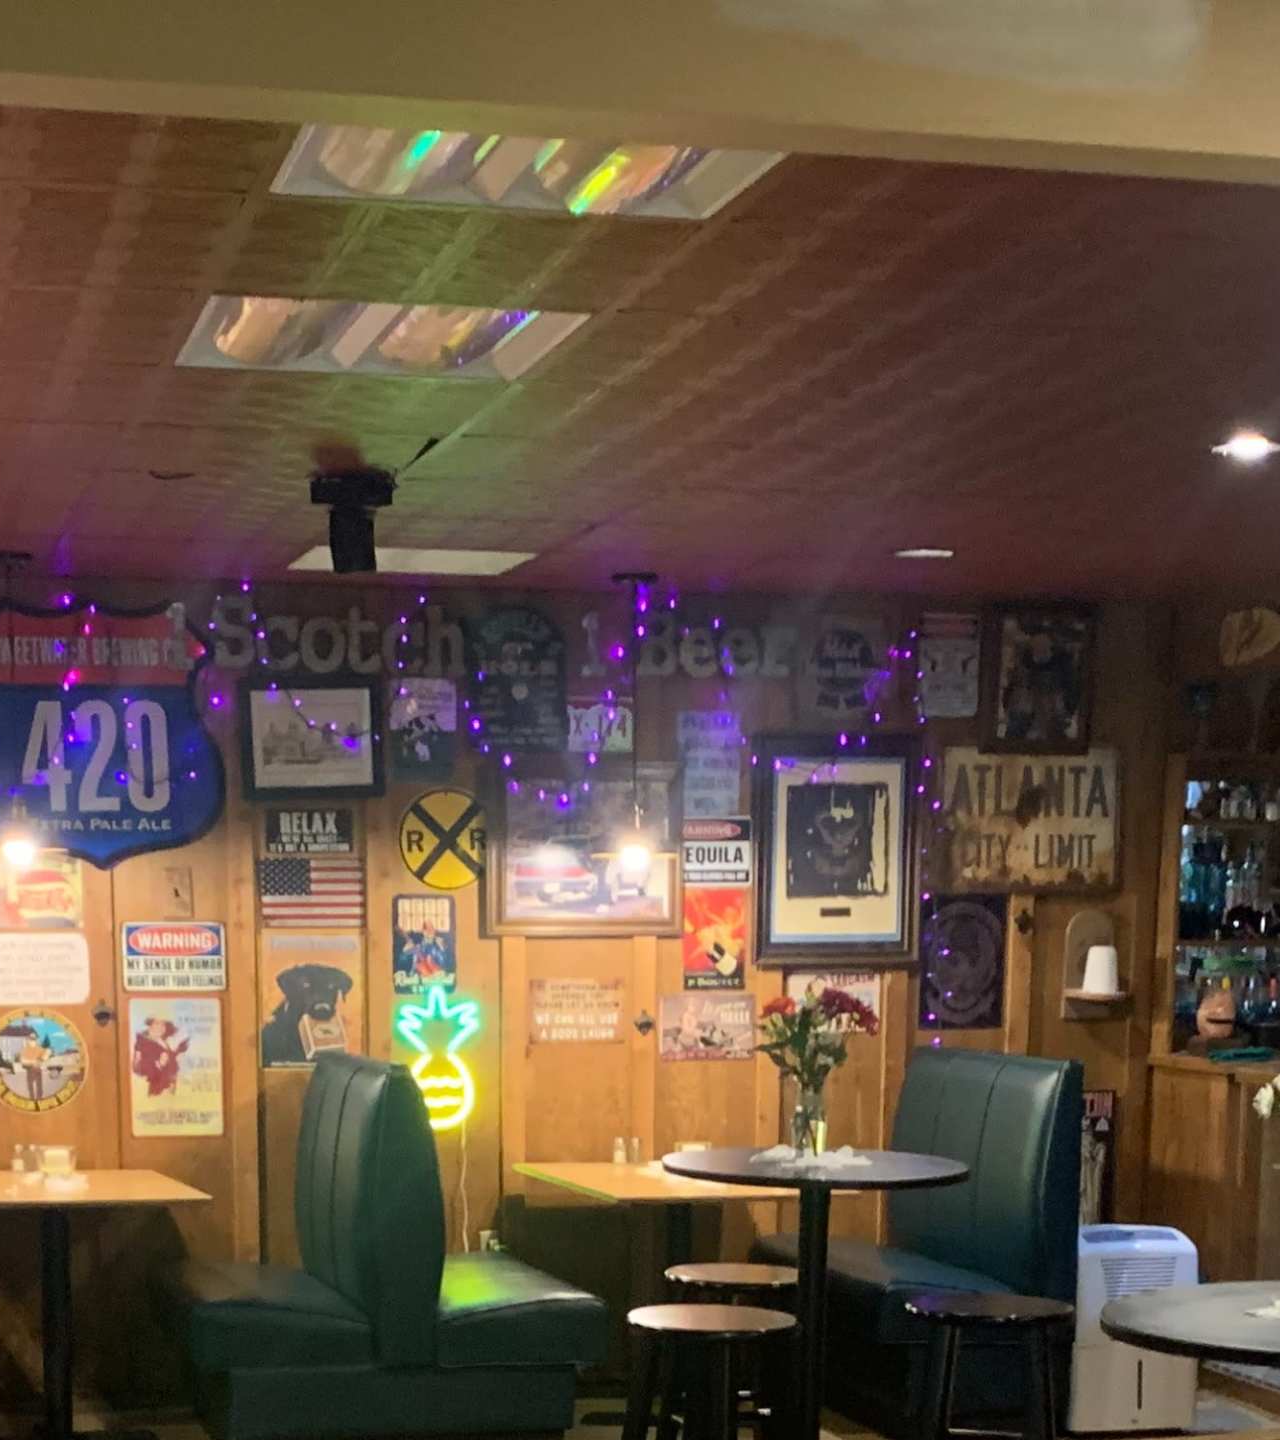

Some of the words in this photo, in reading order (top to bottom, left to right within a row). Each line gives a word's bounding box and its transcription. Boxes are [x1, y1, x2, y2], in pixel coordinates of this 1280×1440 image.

[211, 596, 466, 676] Scotch
[22, 700, 170, 813] 420
[951, 763, 1109, 820] ATLANTA
[89, 816, 132, 831] PALE
[137, 815, 172, 831] ALE
[280, 812, 337, 834] RELAX
[406, 831, 424, 853] R
[470, 828, 487, 851] R
[1033, 833, 1097, 870] LIMIT
[685, 845, 744, 865] EQUILA
[137, 931, 212, 951] WARNING
[127, 958, 140, 970] MY
[143, 958, 171, 970] SENSE
[175, 958, 186, 970] OF
[188, 957, 222, 970] HUMOR
